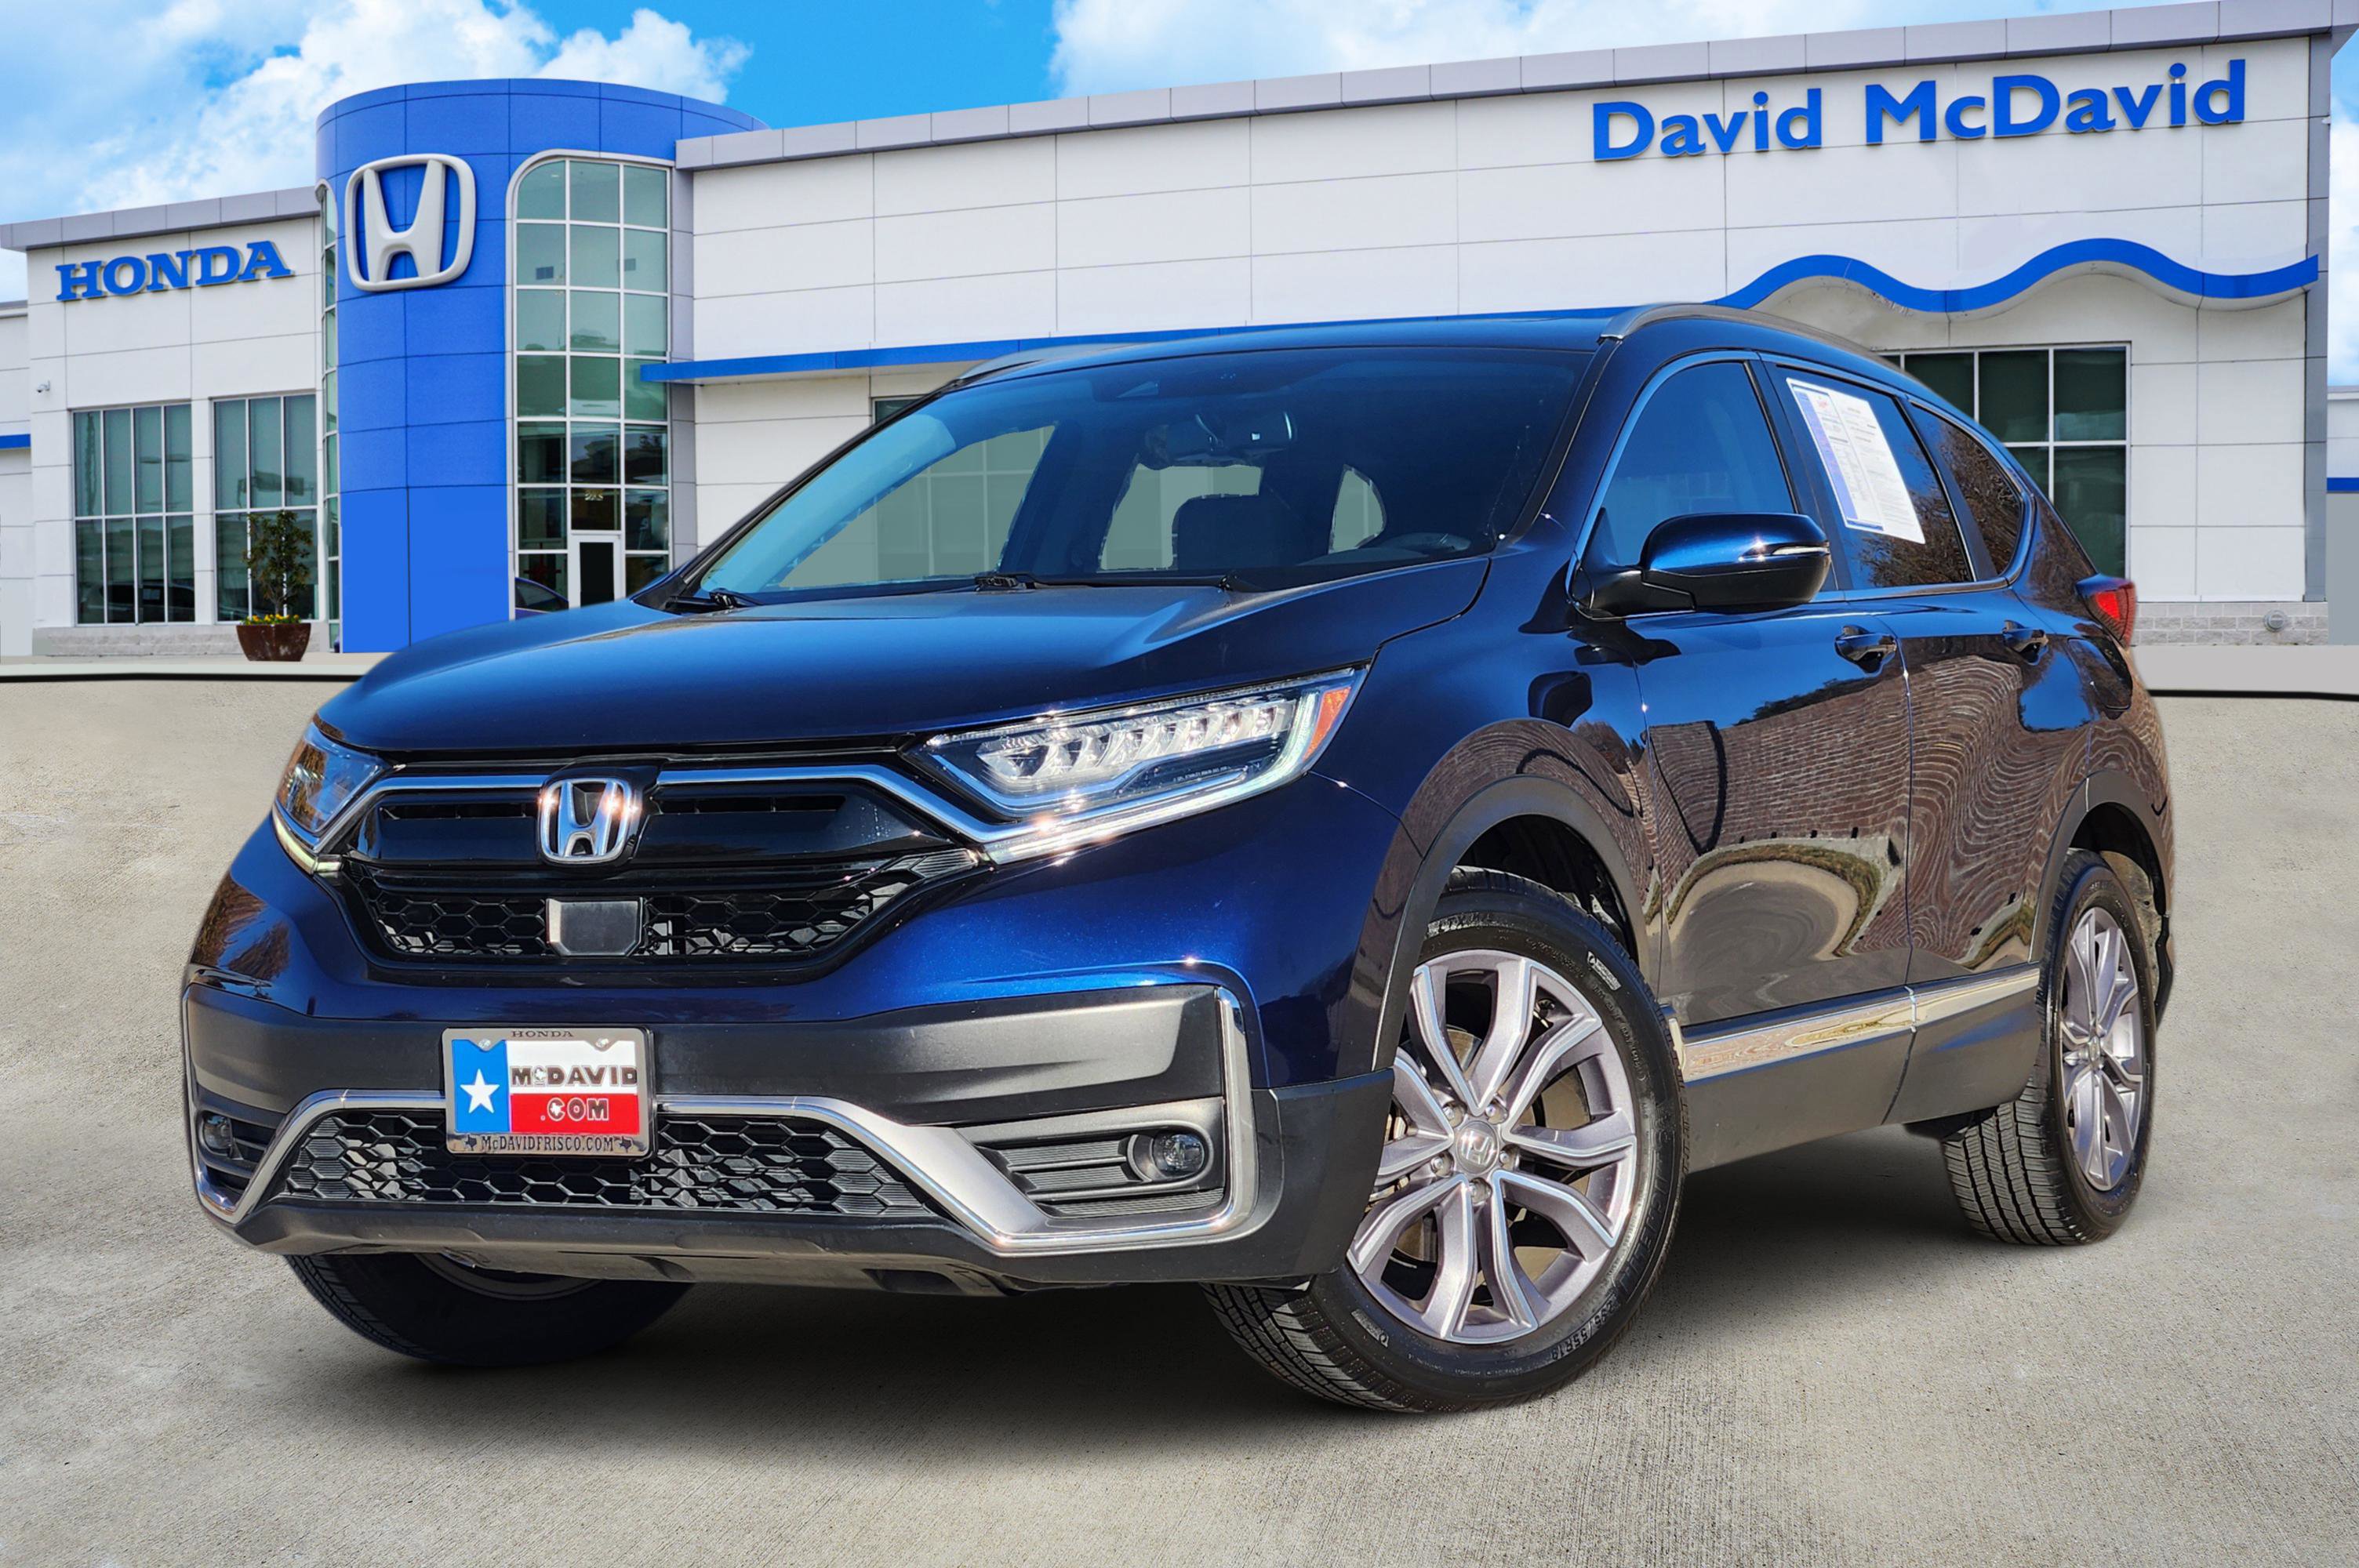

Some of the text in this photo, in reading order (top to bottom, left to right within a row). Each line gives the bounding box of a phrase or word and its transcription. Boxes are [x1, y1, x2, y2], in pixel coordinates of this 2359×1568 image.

[1593, 60, 2246, 162] David McDavid
[55, 240, 293, 302] HONDA
[540, 1098, 609, 1121] .COM
